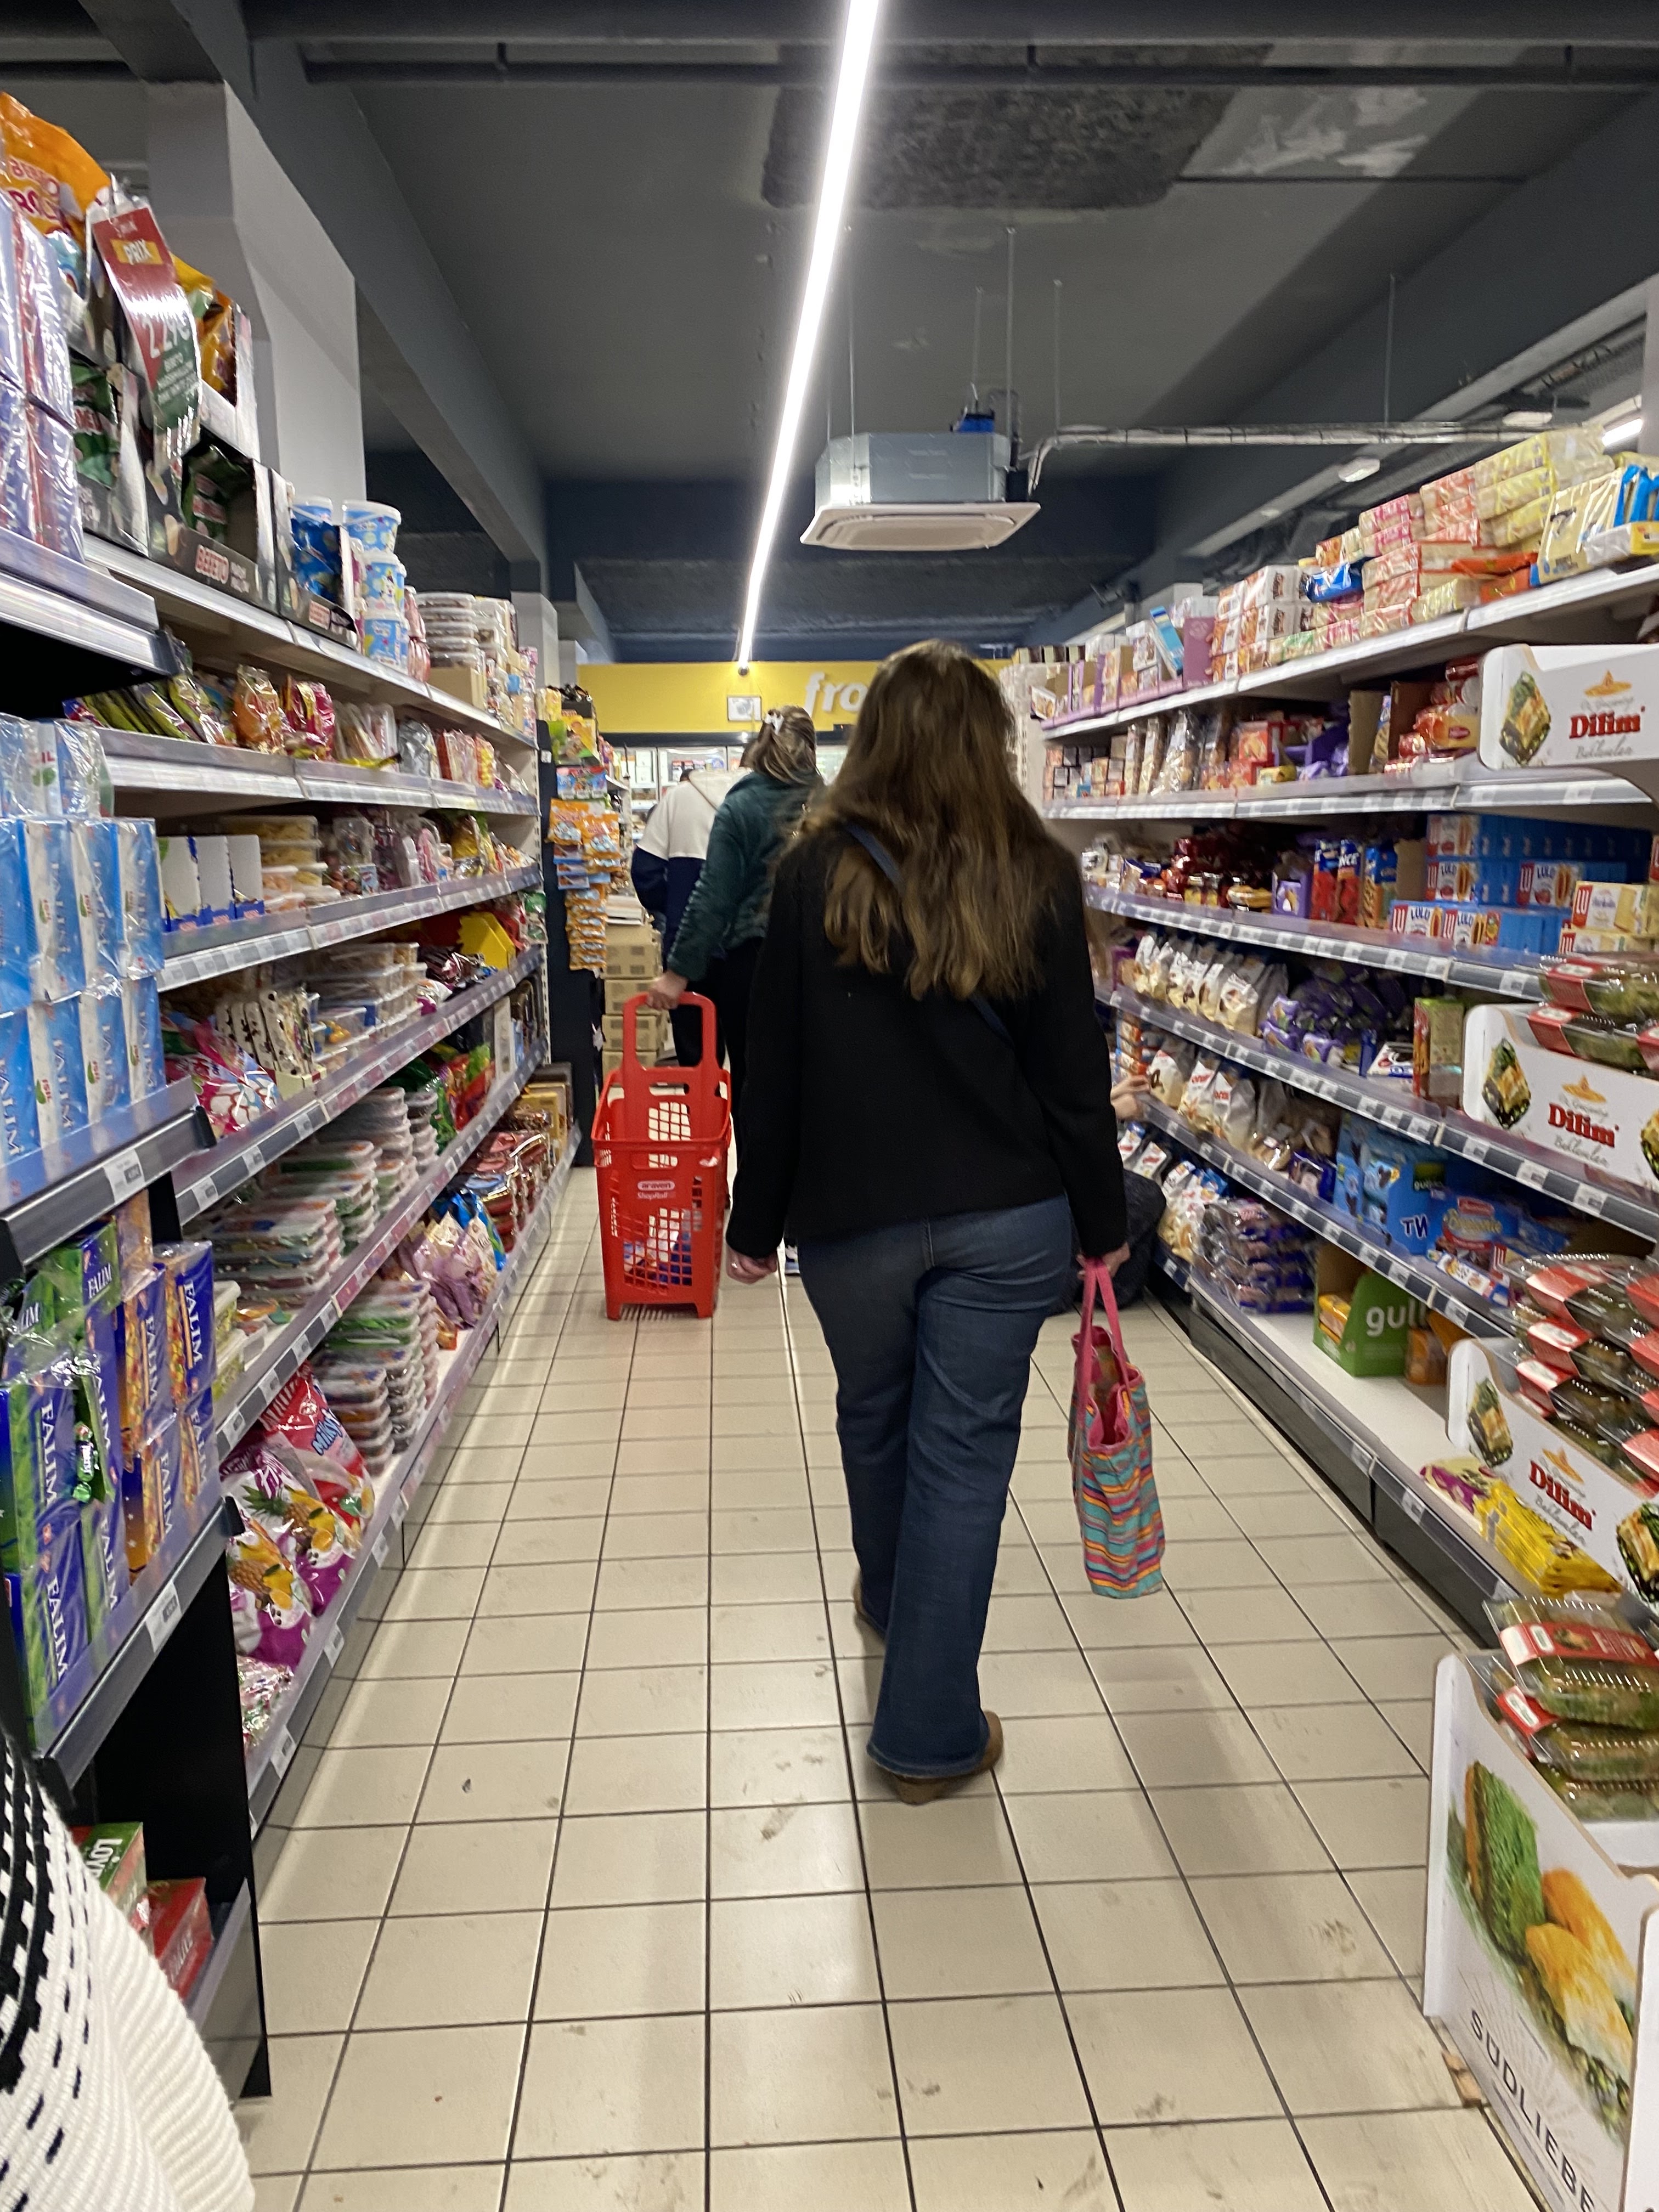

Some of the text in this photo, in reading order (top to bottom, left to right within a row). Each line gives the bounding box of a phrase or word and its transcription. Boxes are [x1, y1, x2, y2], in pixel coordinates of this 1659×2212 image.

[122, 238, 153, 266] PRIX
[1568, 710, 1641, 739] Dilim
[1520, 867, 1533, 893] LU
[1576, 889, 1590, 915] LU
[1392, 908, 1406, 933] LU
[1443, 913, 1456, 939] LU
[1548, 1102, 1615, 1148] Dilim
[87, 1263, 113, 1299] FALIM
[184, 1279, 204, 1364] FALIM
[41, 1398, 58, 1509] FALIM
[1528, 1459, 1593, 1531] Dilim
[47, 1575, 68, 1681] FALIM
